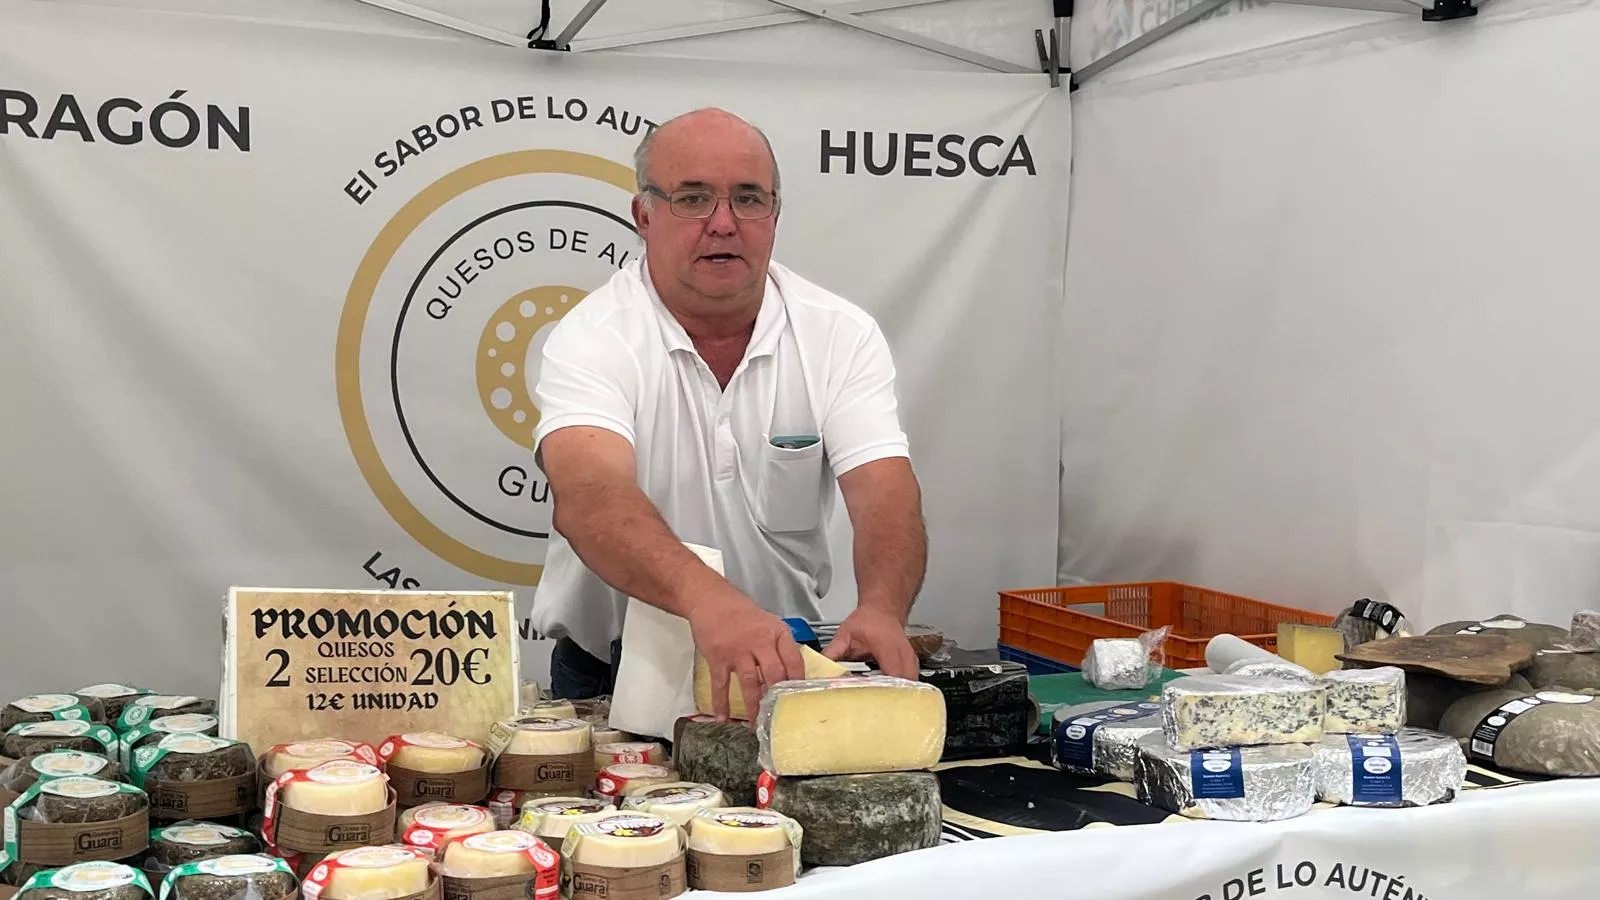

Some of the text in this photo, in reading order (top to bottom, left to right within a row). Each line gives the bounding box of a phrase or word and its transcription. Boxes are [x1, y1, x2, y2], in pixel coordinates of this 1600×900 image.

[0, 89, 251, 152] RAGÓN
[374, 106, 484, 177] SABOR
[491, 96, 536, 123] DE
[547, 96, 588, 122] LO
[595, 105, 662, 139] AUT
[820, 129, 1037, 178] HUESCA
[426, 231, 535, 320] QUESOS
[550, 228, 589, 253] DE
[498, 465, 549, 503] Gu
[251, 601, 497, 640] PROMOCIÓN
[265, 648, 291, 687] 2
[317, 642, 395, 658] QUESOS
[410, 647, 492, 686] 20€
[305, 663, 407, 684] SELECCIÓN
[307, 692, 439, 712] 12€ UNIDAD
[416, 780, 452, 796] Guara
[537, 765, 571, 780] Guara
[78, 832, 119, 850] Guara
[328, 826, 367, 842] Guara
[573, 874, 606, 895] Guara
[1223, 868, 1266, 900] DE
[1277, 861, 1317, 889] LO
